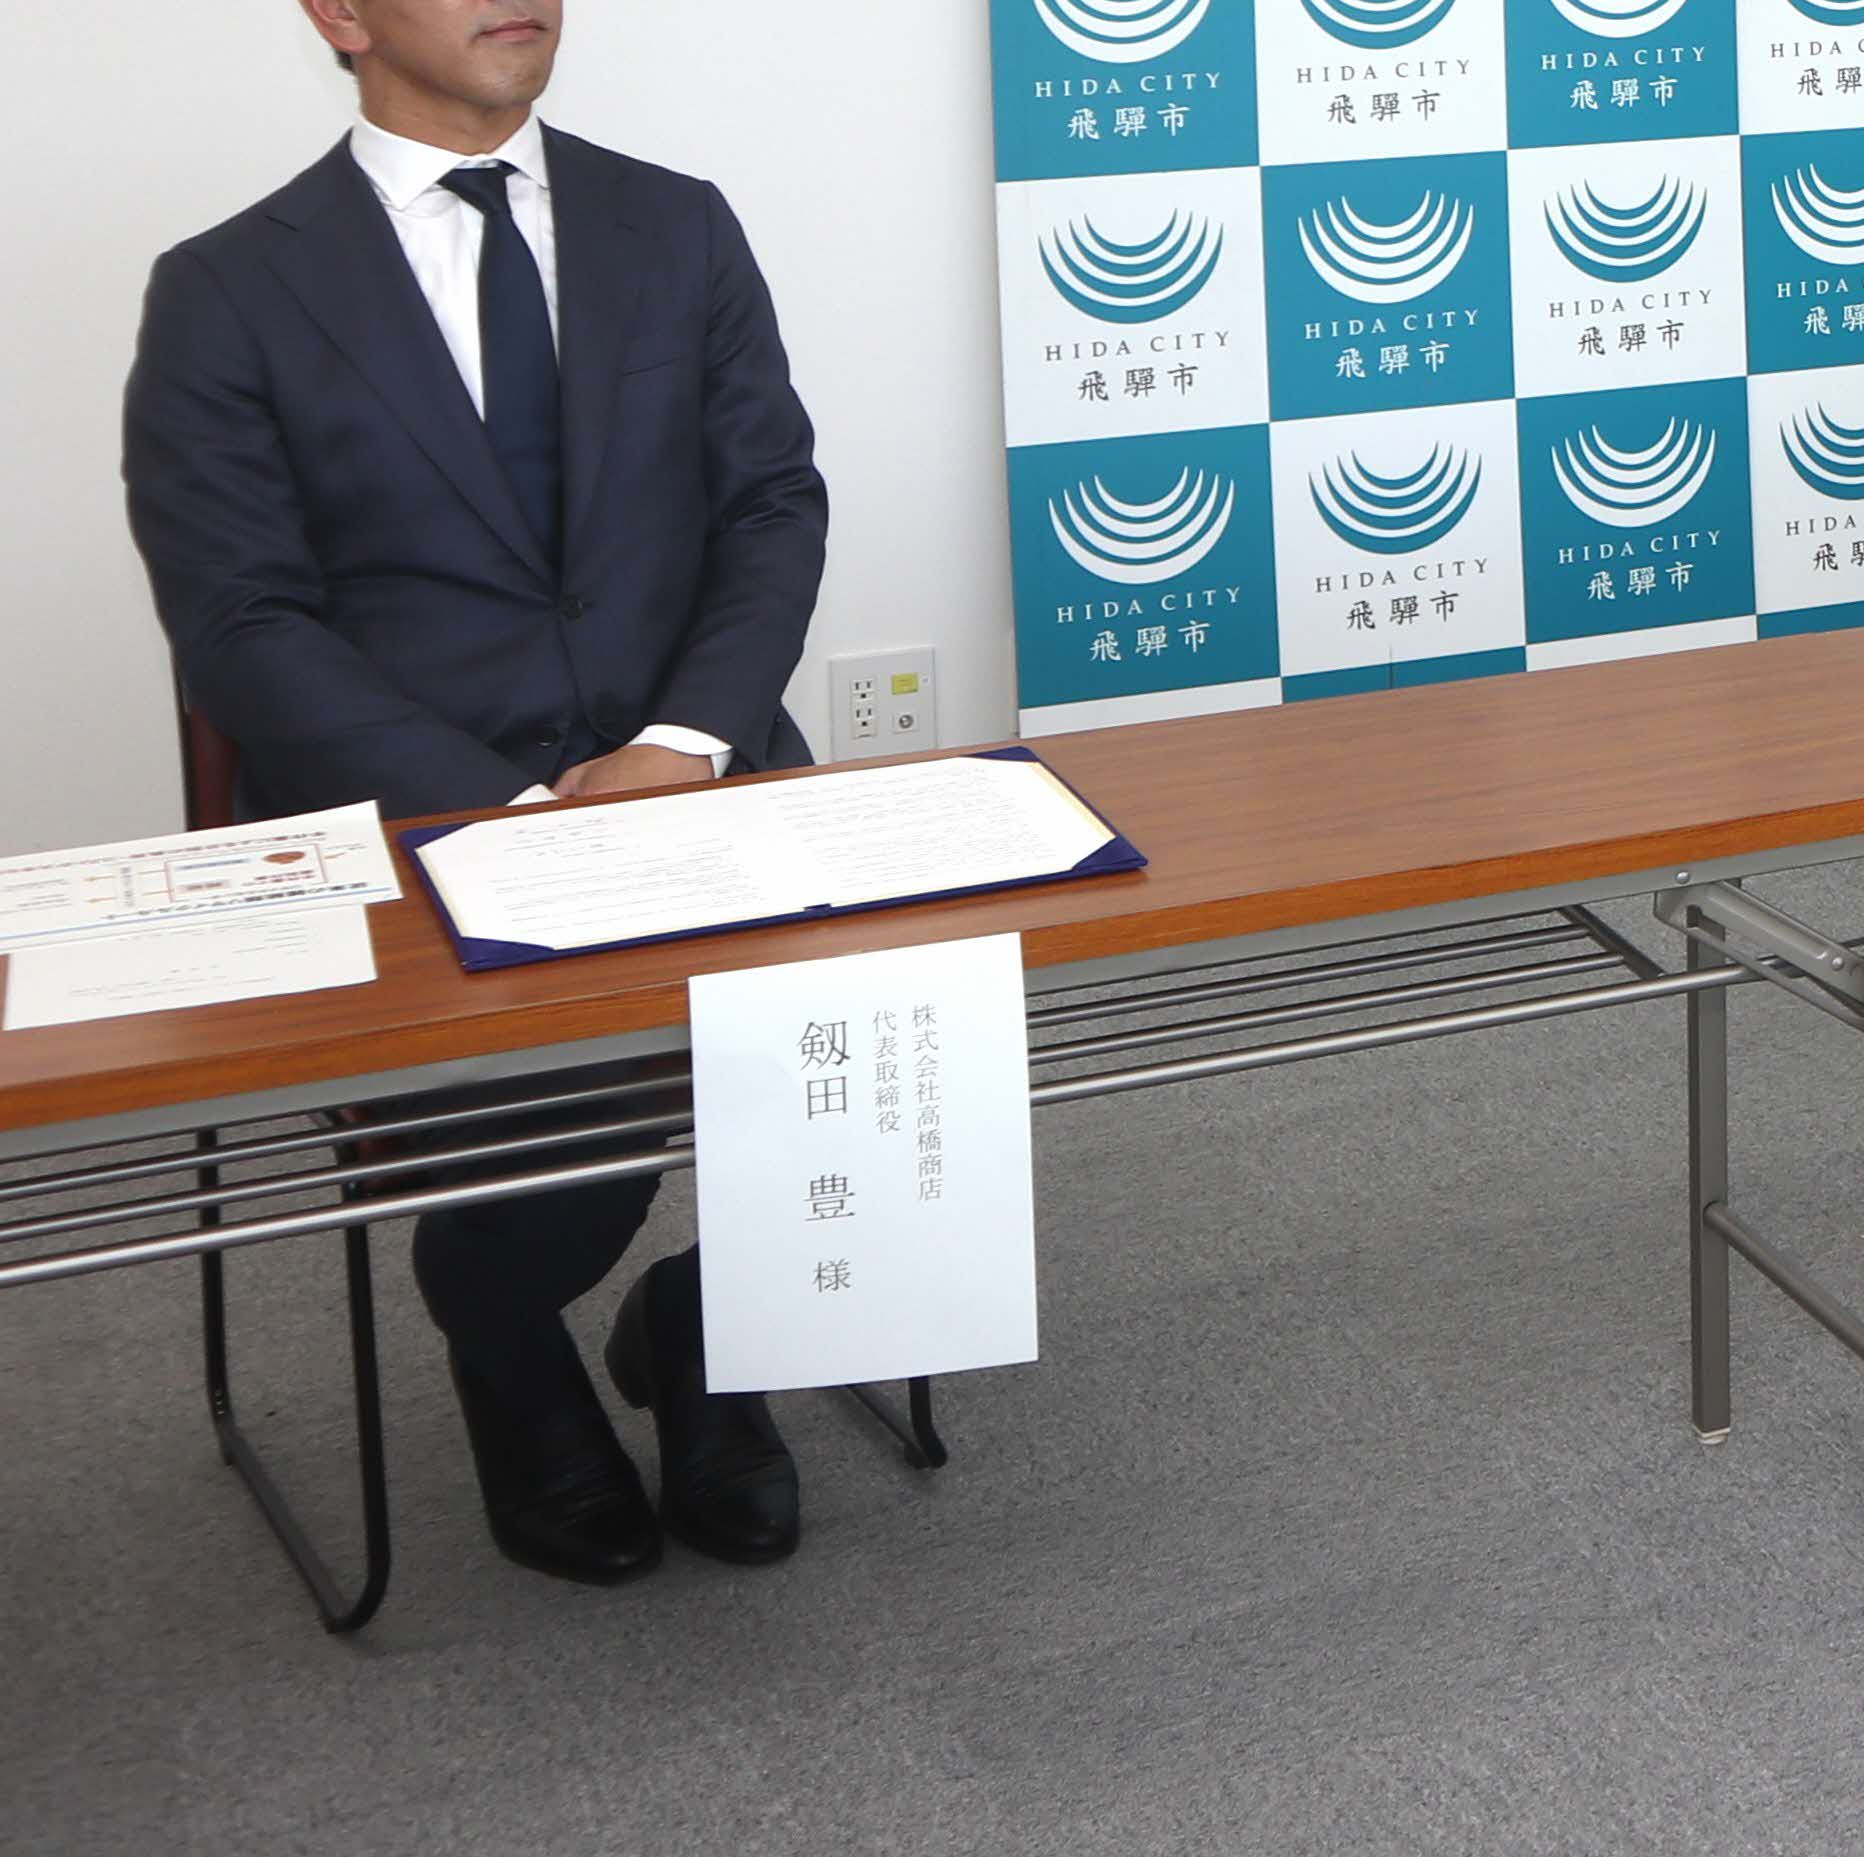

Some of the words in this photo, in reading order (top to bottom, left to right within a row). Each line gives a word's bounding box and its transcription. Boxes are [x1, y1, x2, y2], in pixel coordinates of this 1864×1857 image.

[1296, 64, 1378, 85] HIDA
[1394, 59, 1470, 79] CITY
[1541, 51, 1619, 71] HIDA
[1633, 46, 1705, 66] CITY
[1035, 78, 1123, 98] HIDA
[1139, 71, 1220, 93] CITY
[1776, 277, 1849, 299] HIDA
[1304, 317, 1387, 340] HIDA
[1402, 309, 1478, 332] CITY
[1045, 339, 1132, 362] HIDA
[1149, 331, 1229, 353] CITY
[1785, 514, 1857, 537] HIDA
[1558, 541, 1635, 565] HIDA
[1649, 530, 1720, 553] CITY
[1316, 569, 1397, 594] HIDA
[1413, 558, 1488, 582] CITY
[1057, 599, 1143, 624] HIDA
[1160, 586, 1240, 612] CITY
[871, 1009, 902, 1134] 代表取締役
[912, 1002, 944, 1202] 株式会社高橋商店
[803, 1173, 856, 1222] 豊
[812, 1258, 852, 1293] 様
